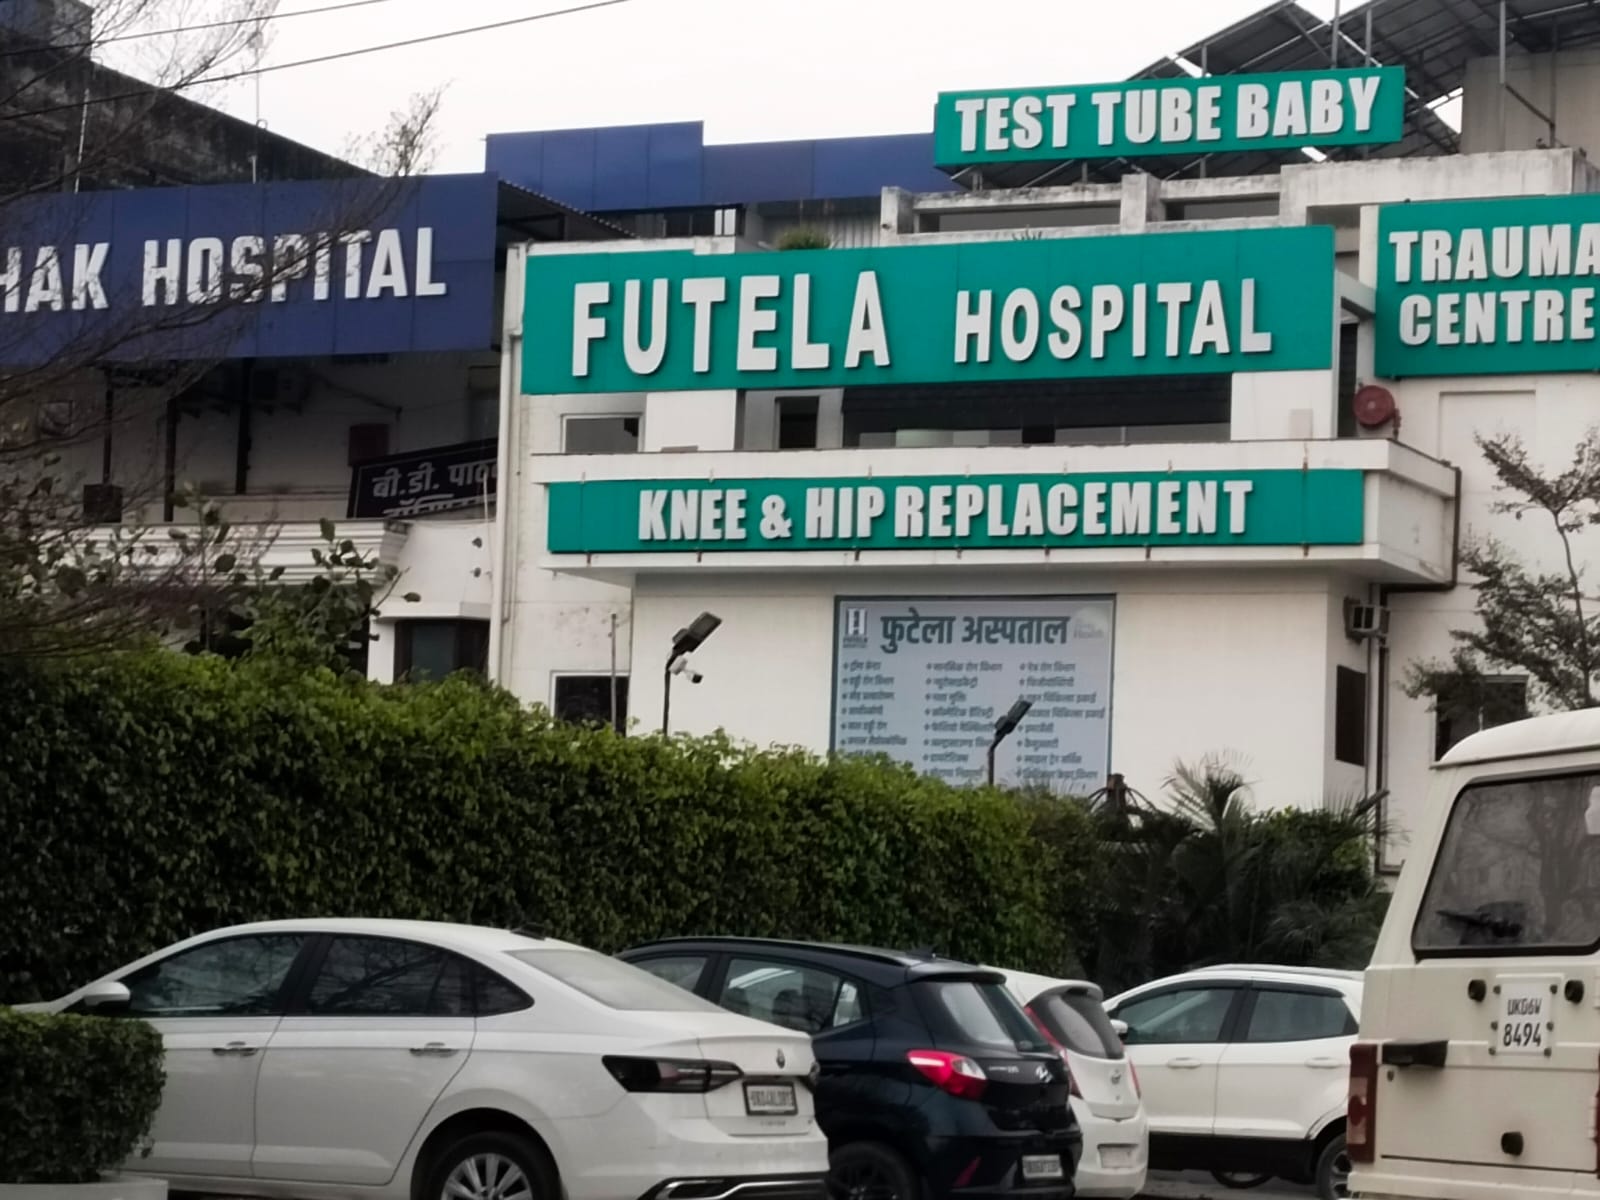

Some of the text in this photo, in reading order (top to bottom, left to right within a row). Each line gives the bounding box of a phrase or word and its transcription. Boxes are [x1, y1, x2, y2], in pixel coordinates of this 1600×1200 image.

[955, 76, 1382, 152] TEST TUBE BABY
[142, 226, 447, 307] HOSPITAL
[1388, 223, 1600, 283] TRAUMA
[572, 270, 1272, 377] FUTELA HOSPITAL
[1399, 287, 1595, 345] CENTRE
[638, 480, 1253, 541] KNEE & HIP REPLACEMENT
[879, 606, 956, 654] फुटेला
[961, 615, 1071, 645] अस्पताल
[1503, 1023, 1542, 1047] 8494
